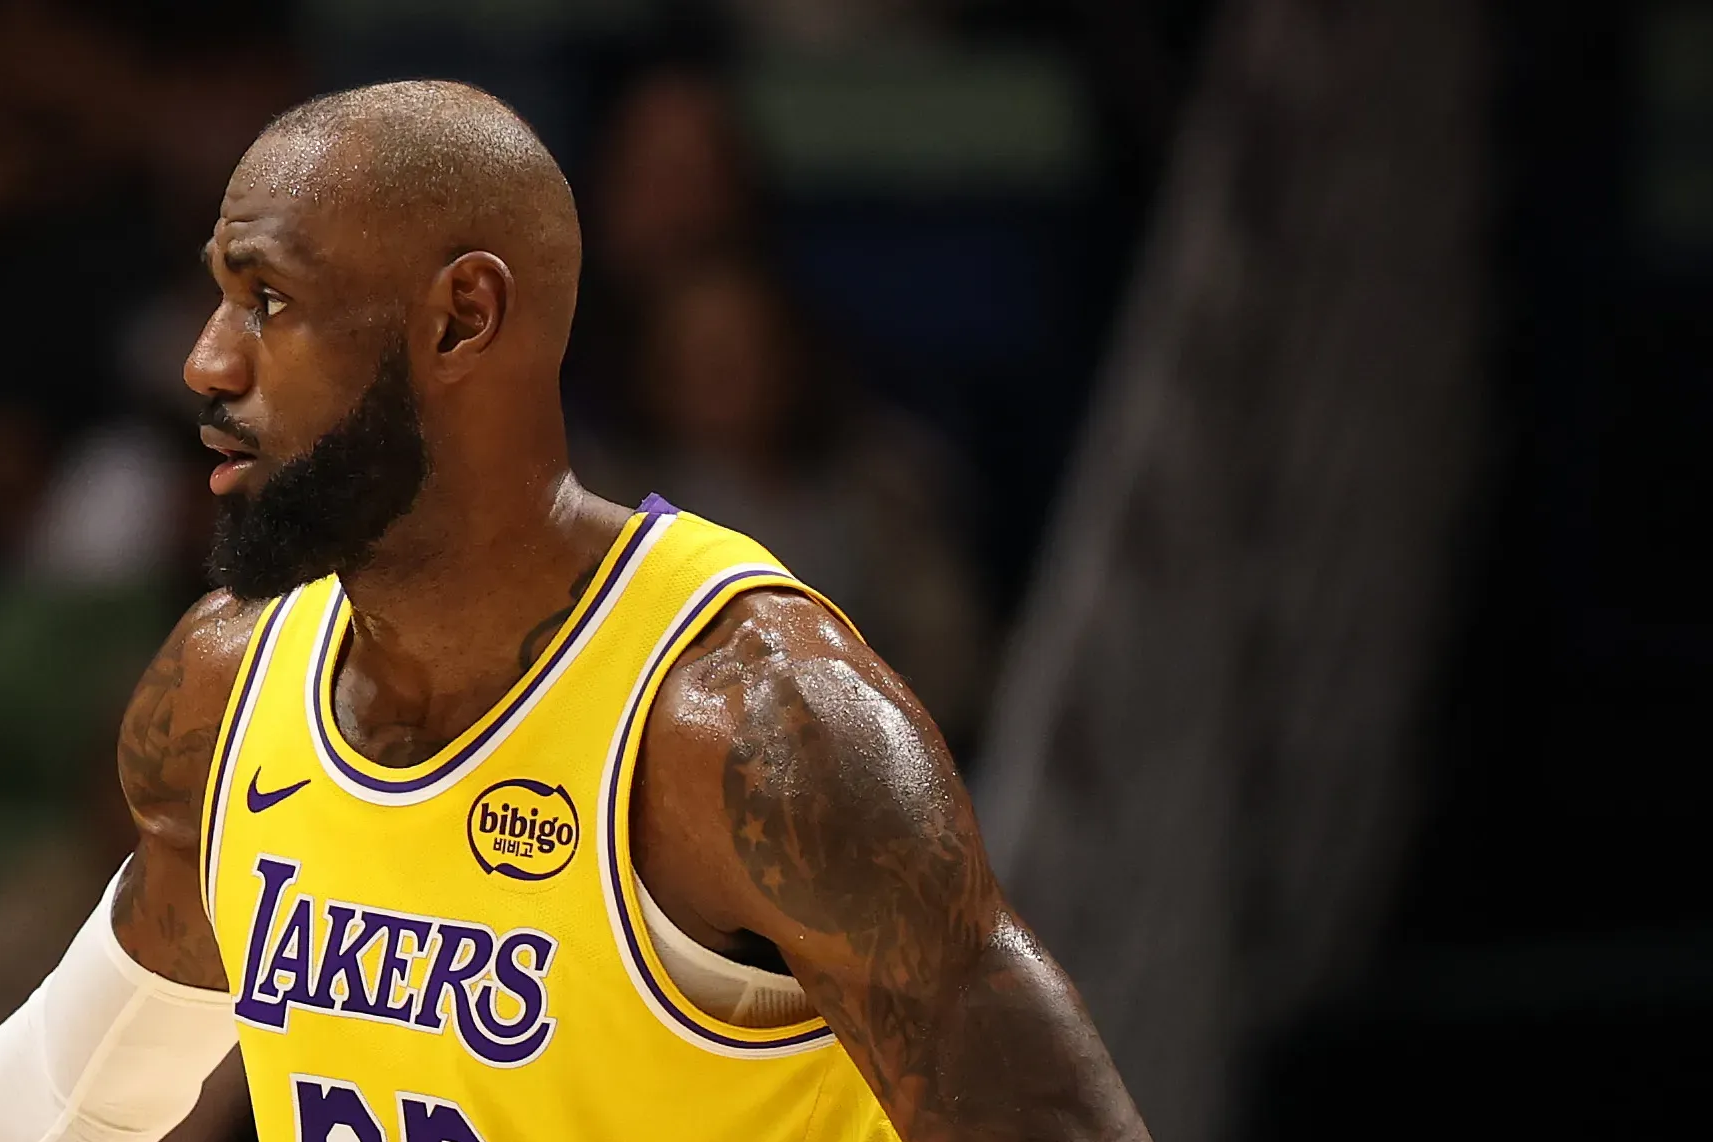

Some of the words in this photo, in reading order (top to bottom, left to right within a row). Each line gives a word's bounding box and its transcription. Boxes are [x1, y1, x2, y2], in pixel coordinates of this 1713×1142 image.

[479, 802, 574, 853] bibigo
[493, 838, 534, 858] 비비고
[234, 853, 559, 1069] LAKERS
